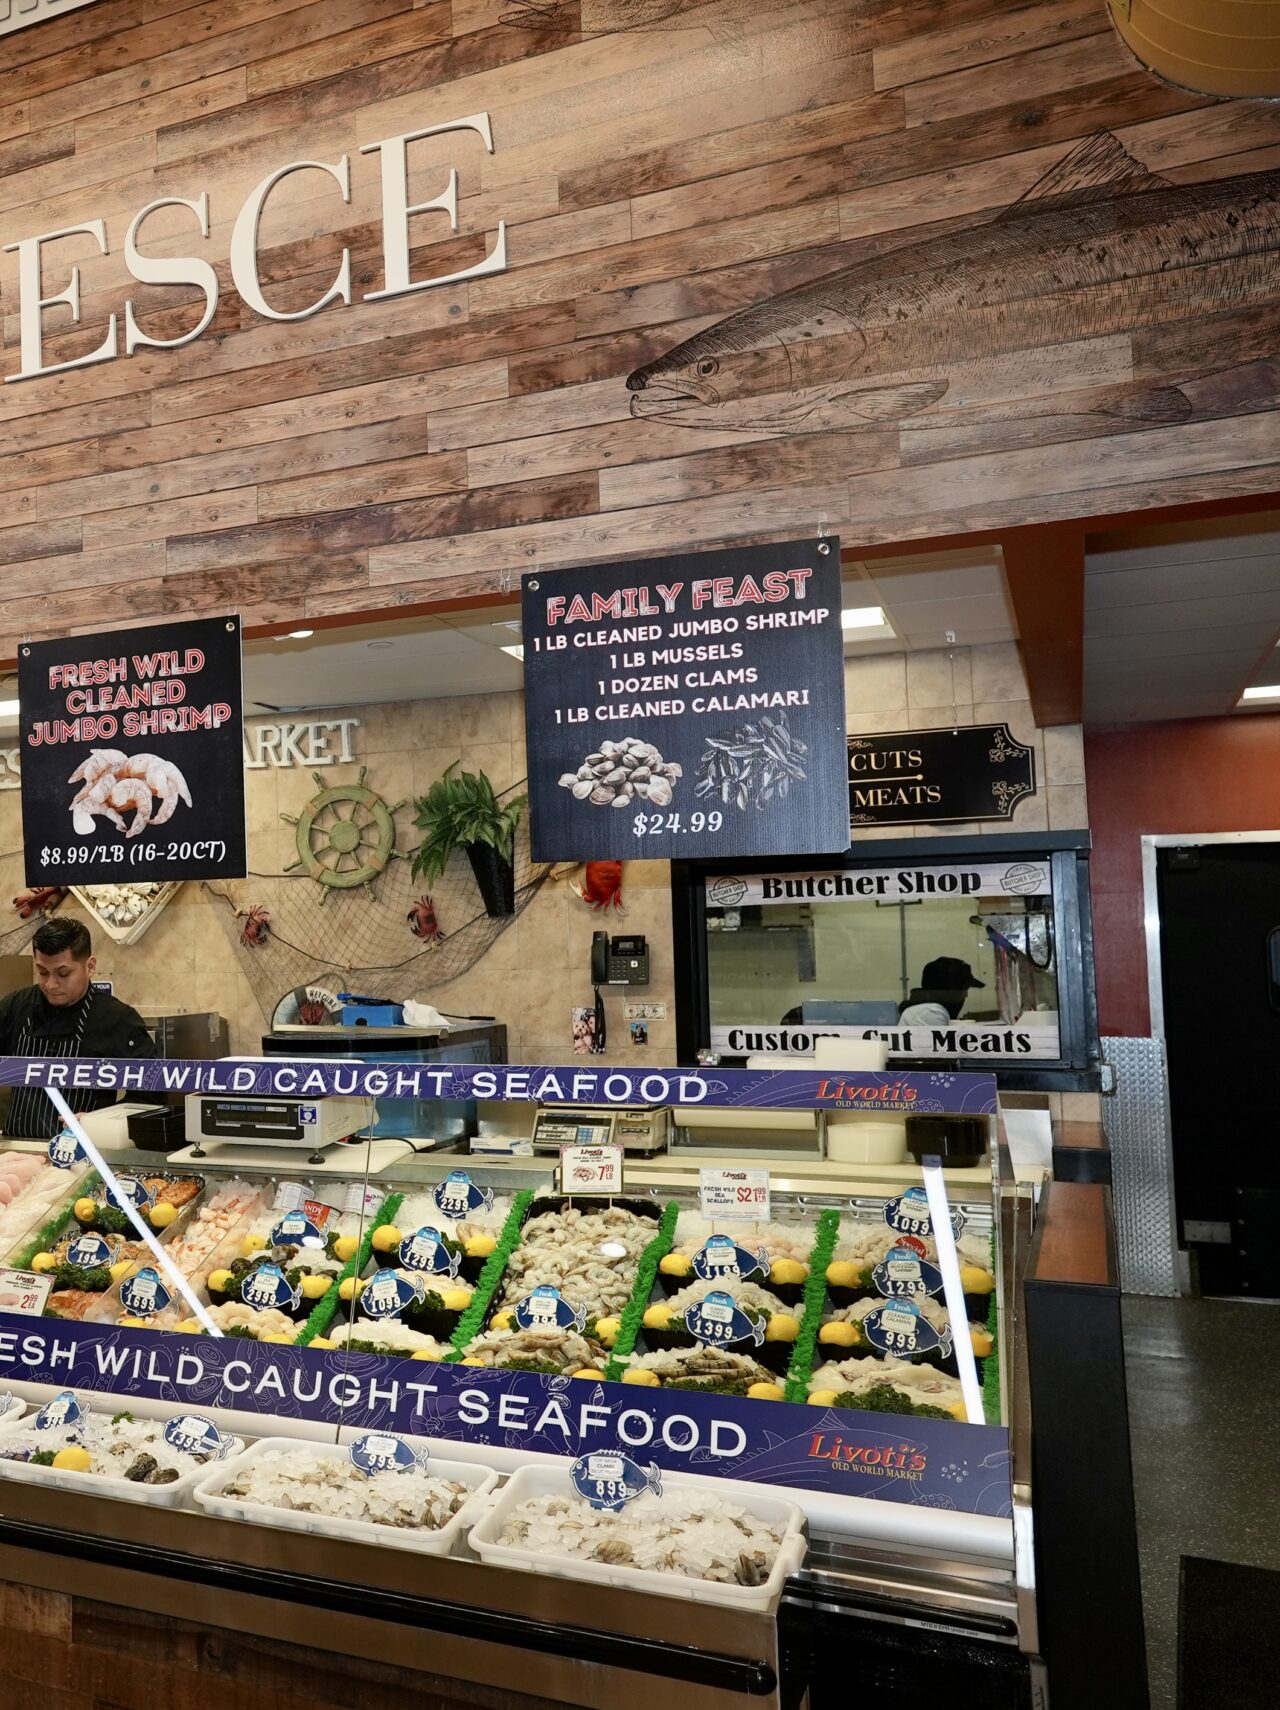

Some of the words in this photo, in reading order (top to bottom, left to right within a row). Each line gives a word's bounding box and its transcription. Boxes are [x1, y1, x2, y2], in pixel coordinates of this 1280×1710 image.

[546, 582, 684, 626] FAMILY
[692, 568, 812, 610] FEAST
[533, 637, 540, 652] 1
[546, 635, 567, 651] LB
[573, 625, 662, 648] CLEANED
[668, 617, 739, 639] JUMBO
[745, 608, 830, 632] SHRIMP
[610, 654, 617, 669] 1
[623, 652, 646, 668] LB
[651, 642, 744, 666] MUSSELS
[48, 657, 127, 690] FRESH
[133, 648, 205, 680] WILD
[598, 680, 605, 695] 1
[611, 673, 678, 695] DOZEN
[685, 667, 758, 687] CLAMS
[66, 678, 187, 716] CLEANED
[554, 709, 561, 724] 1
[567, 707, 590, 723] LB
[594, 699, 685, 721] CLEANED
[691, 689, 810, 713] CALAMARI
[27, 714, 118, 747] JUMBO
[122, 702, 232, 738] SHRIMP
[244, 719, 359, 768] RKET
[850, 749, 923, 772] CUTS
[854, 784, 942, 809] MEATS
[632, 811, 723, 837] $24.99
[40, 844, 125, 867] $8.99/LB
[129, 839, 227, 865] (16-20CT)
[761, 873, 890, 900] Butcher
[898, 870, 982, 895] Shop
[729, 1028, 840, 1051] Custo
[931, 1030, 1033, 1053] Meats
[24, 1063, 145, 1090] FRESH
[162, 1066, 258, 1092] WILD
[273, 1067, 454, 1095] CAUGHT
[471, 1071, 709, 1103] SEAFOOD
[816, 1078, 918, 1101] Livoti's
[835, 1100, 852, 1108] OLD
[853, 1100, 881, 1109] WORLD
[882, 1101, 915, 1109] MARKET
[440, 1196, 470, 1212] 2299
[891, 1214, 930, 1236] 1099
[77, 1253, 97, 1265] 199
[404, 1251, 436, 1271] 1299
[247, 1288, 277, 1306] 2999
[886, 1280, 927, 1295] 1299
[125, 1294, 156, 1312] 1699
[371, 1295, 402, 1313] 1099
[693, 1320, 733, 1340] 1399
[885, 1331, 917, 1351] 999
[94, 1344, 204, 1386] WILD
[222, 1358, 438, 1417] CAUGHT
[458, 1387, 747, 1458] SEAFOOD
[168, 1430, 201, 1452] 1399
[808, 1433, 928, 1471] Livoti's
[367, 1453, 396, 1470] 999
[831, 1461, 850, 1471] OLD
[851, 1464, 884, 1476] WORLD
[886, 1467, 925, 1481] MARKET
[596, 1480, 627, 1500] 899
